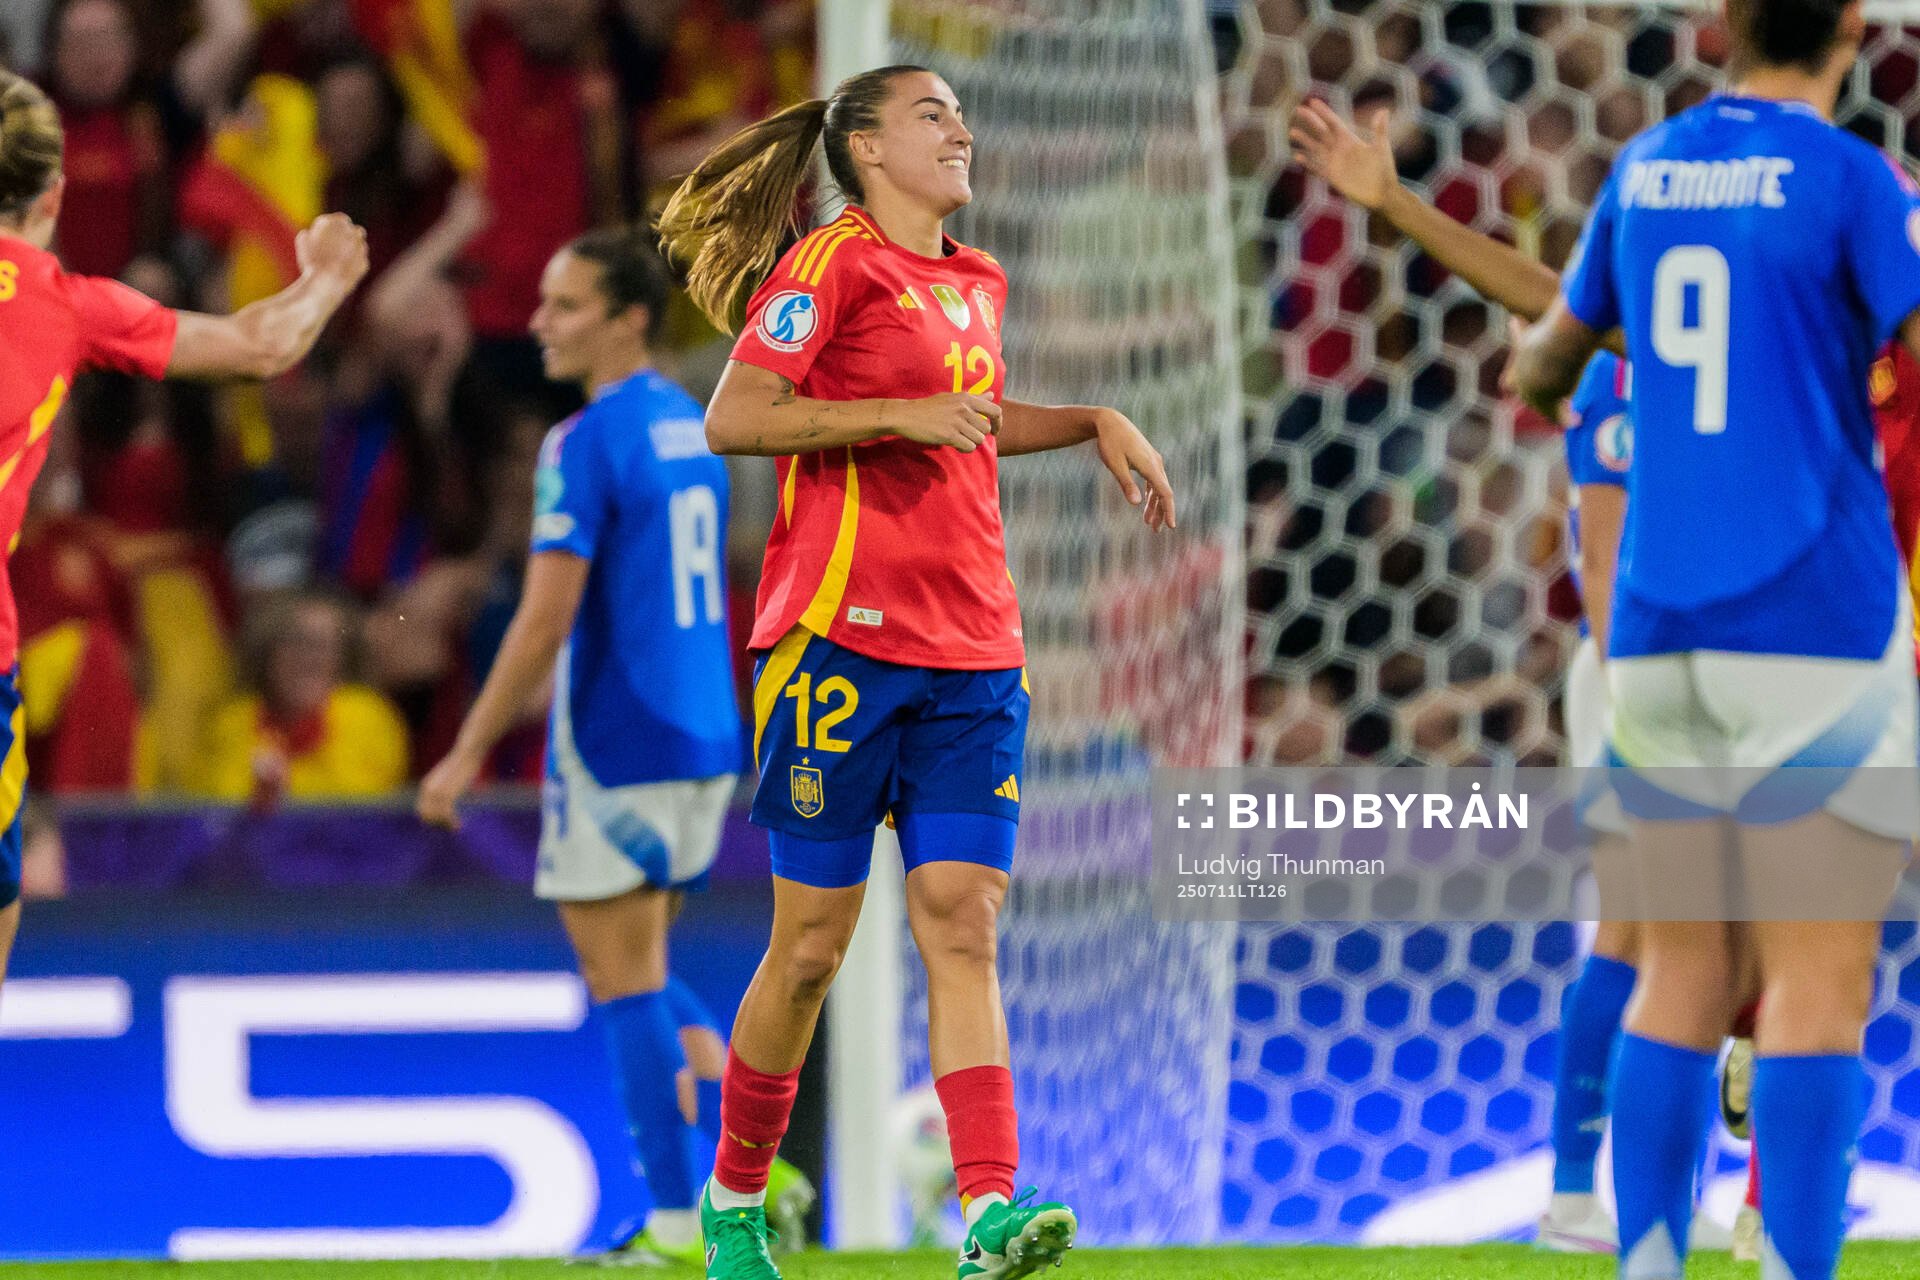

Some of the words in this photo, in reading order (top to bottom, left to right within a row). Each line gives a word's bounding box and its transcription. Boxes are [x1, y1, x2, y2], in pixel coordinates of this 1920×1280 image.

[1621, 156, 1794, 210] PIEMONTE
[944, 341, 995, 396] 12
[1652, 245, 1730, 434] 9
[785, 672, 859, 753] 12
